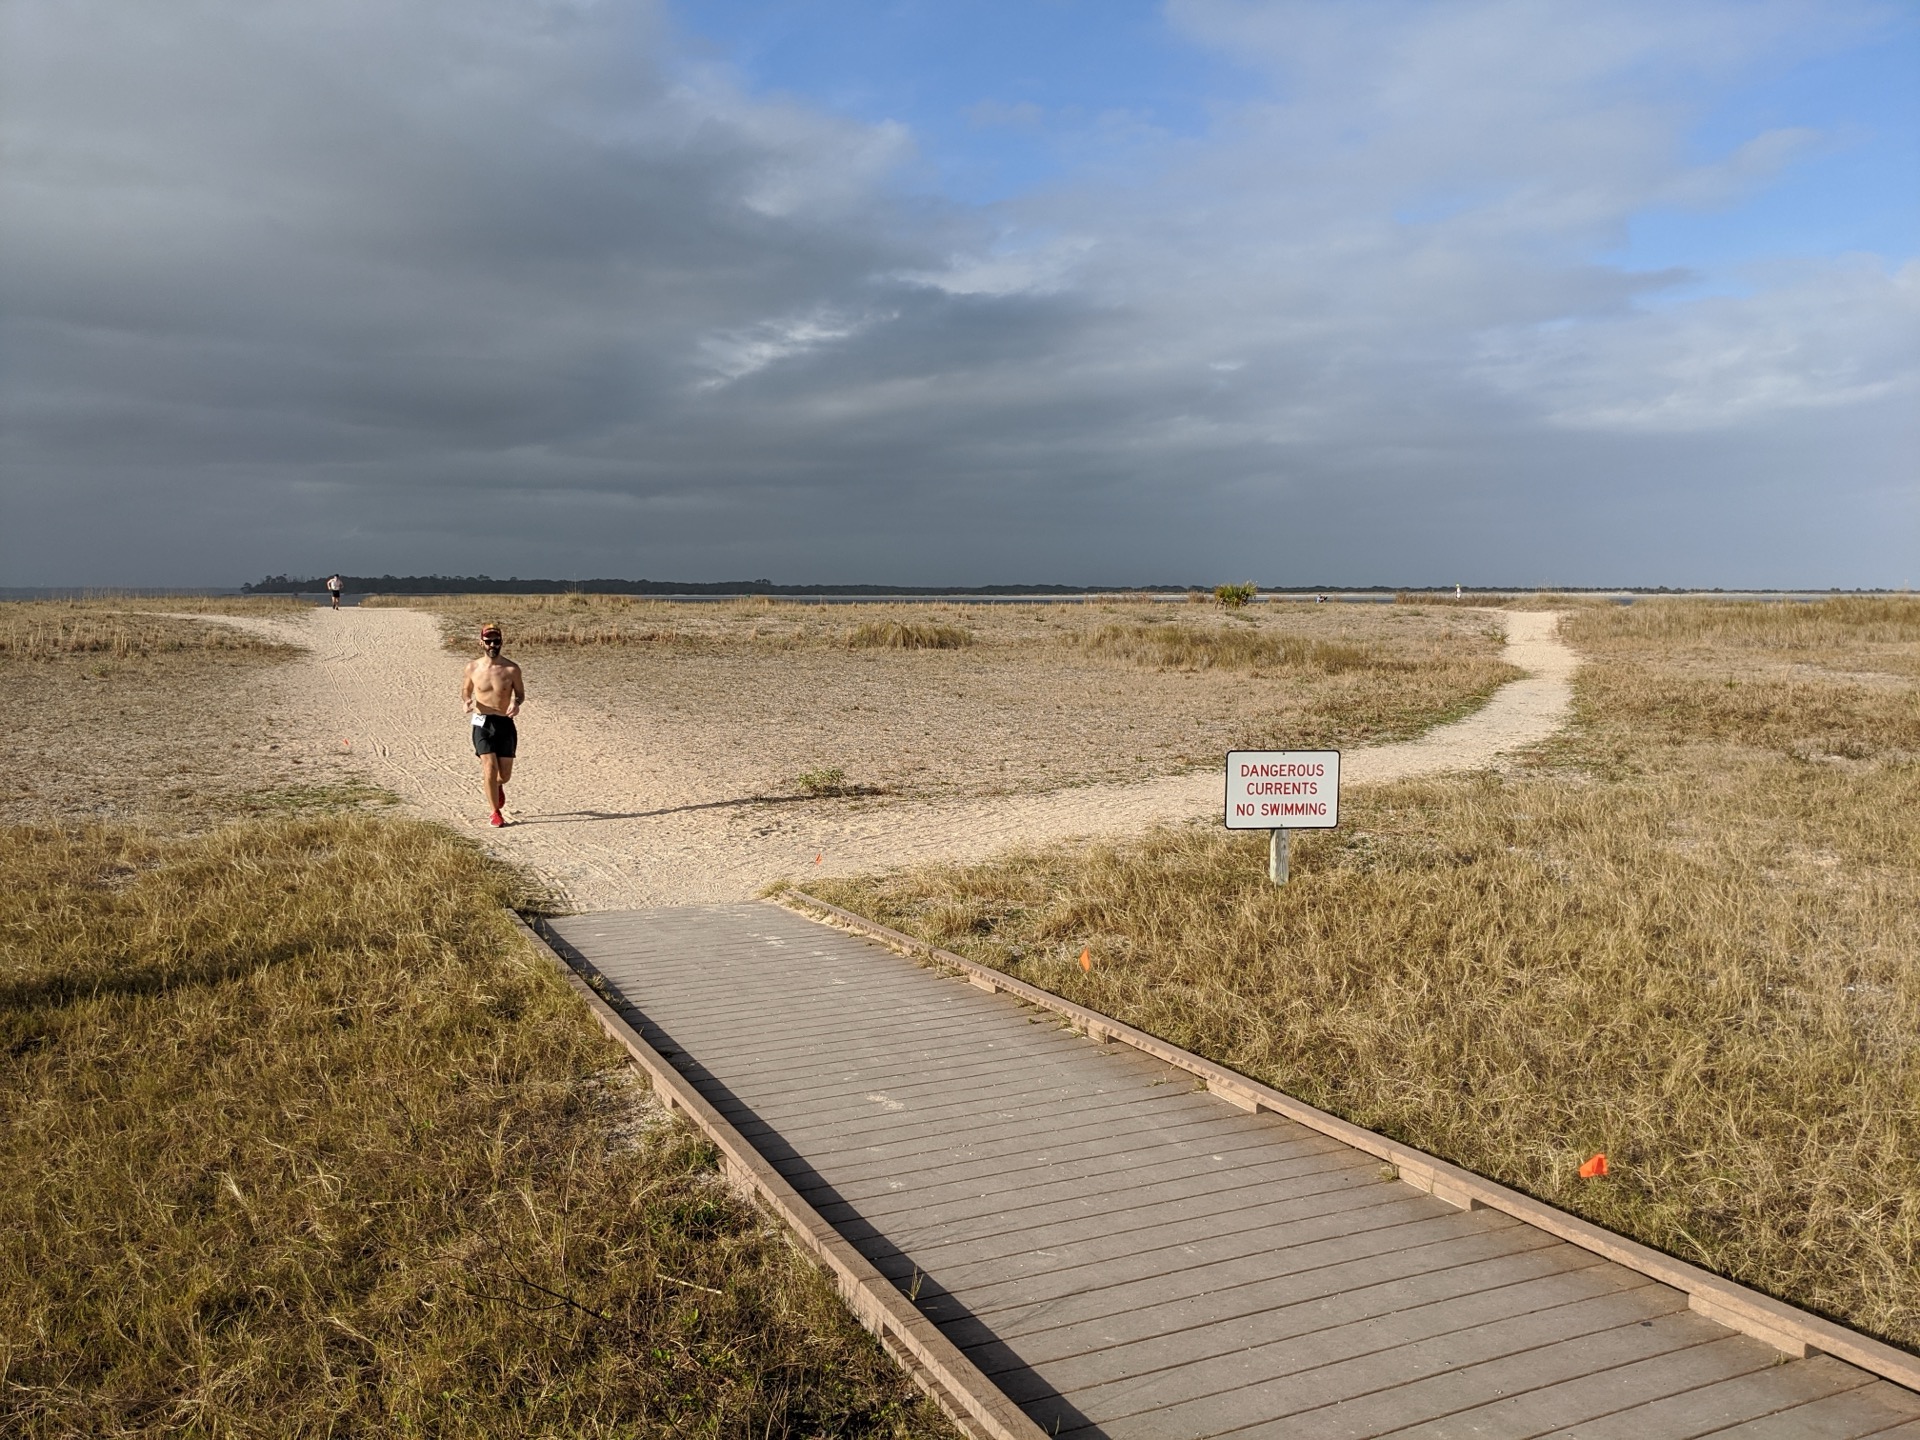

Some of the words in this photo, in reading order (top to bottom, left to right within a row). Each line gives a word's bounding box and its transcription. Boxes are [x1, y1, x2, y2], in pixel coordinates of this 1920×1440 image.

[1241, 764, 1324, 777] DANGEROUS
[1247, 782, 1317, 795] CURRENTS
[1236, 803, 1255, 816] NO
[1261, 803, 1326, 816] SWIMMING
